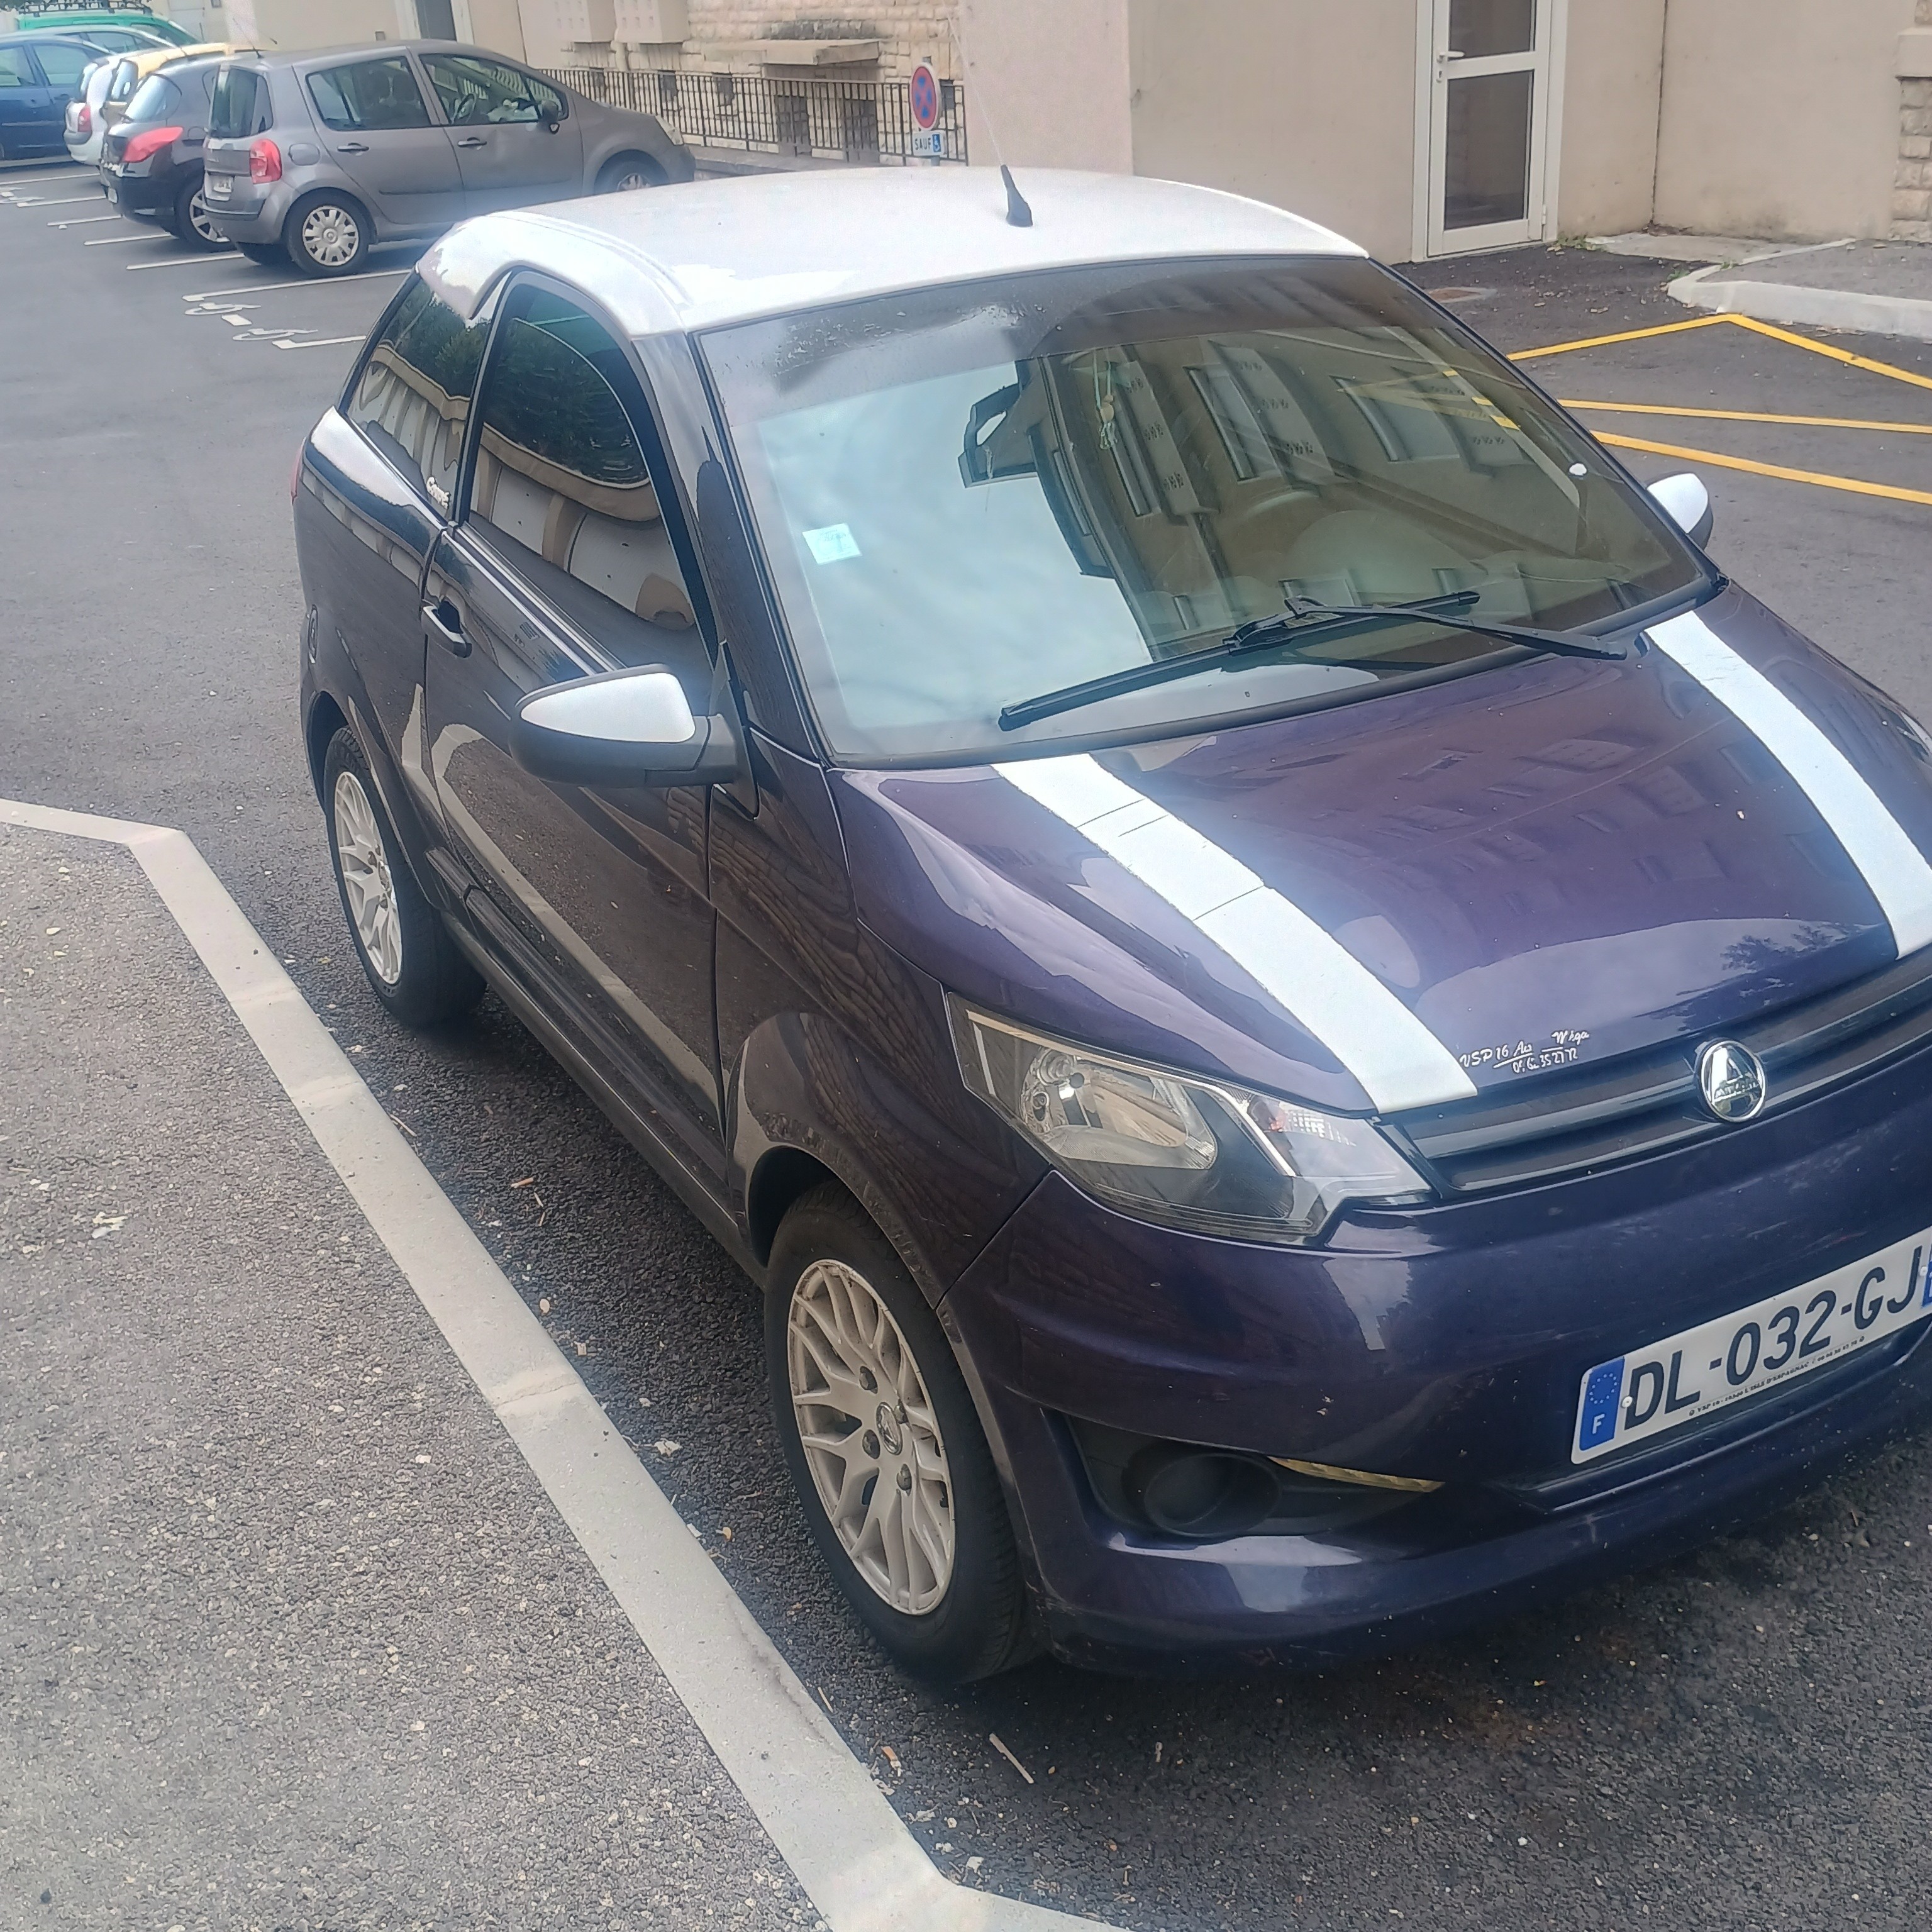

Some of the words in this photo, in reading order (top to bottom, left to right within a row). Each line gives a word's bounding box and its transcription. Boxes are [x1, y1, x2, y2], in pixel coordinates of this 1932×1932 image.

[915, 137, 931, 150] SAUF
[1459, 1048, 1493, 1068] VSP
[1496, 1045, 1509, 1060] 16
[1592, 1413, 1605, 1435] F
